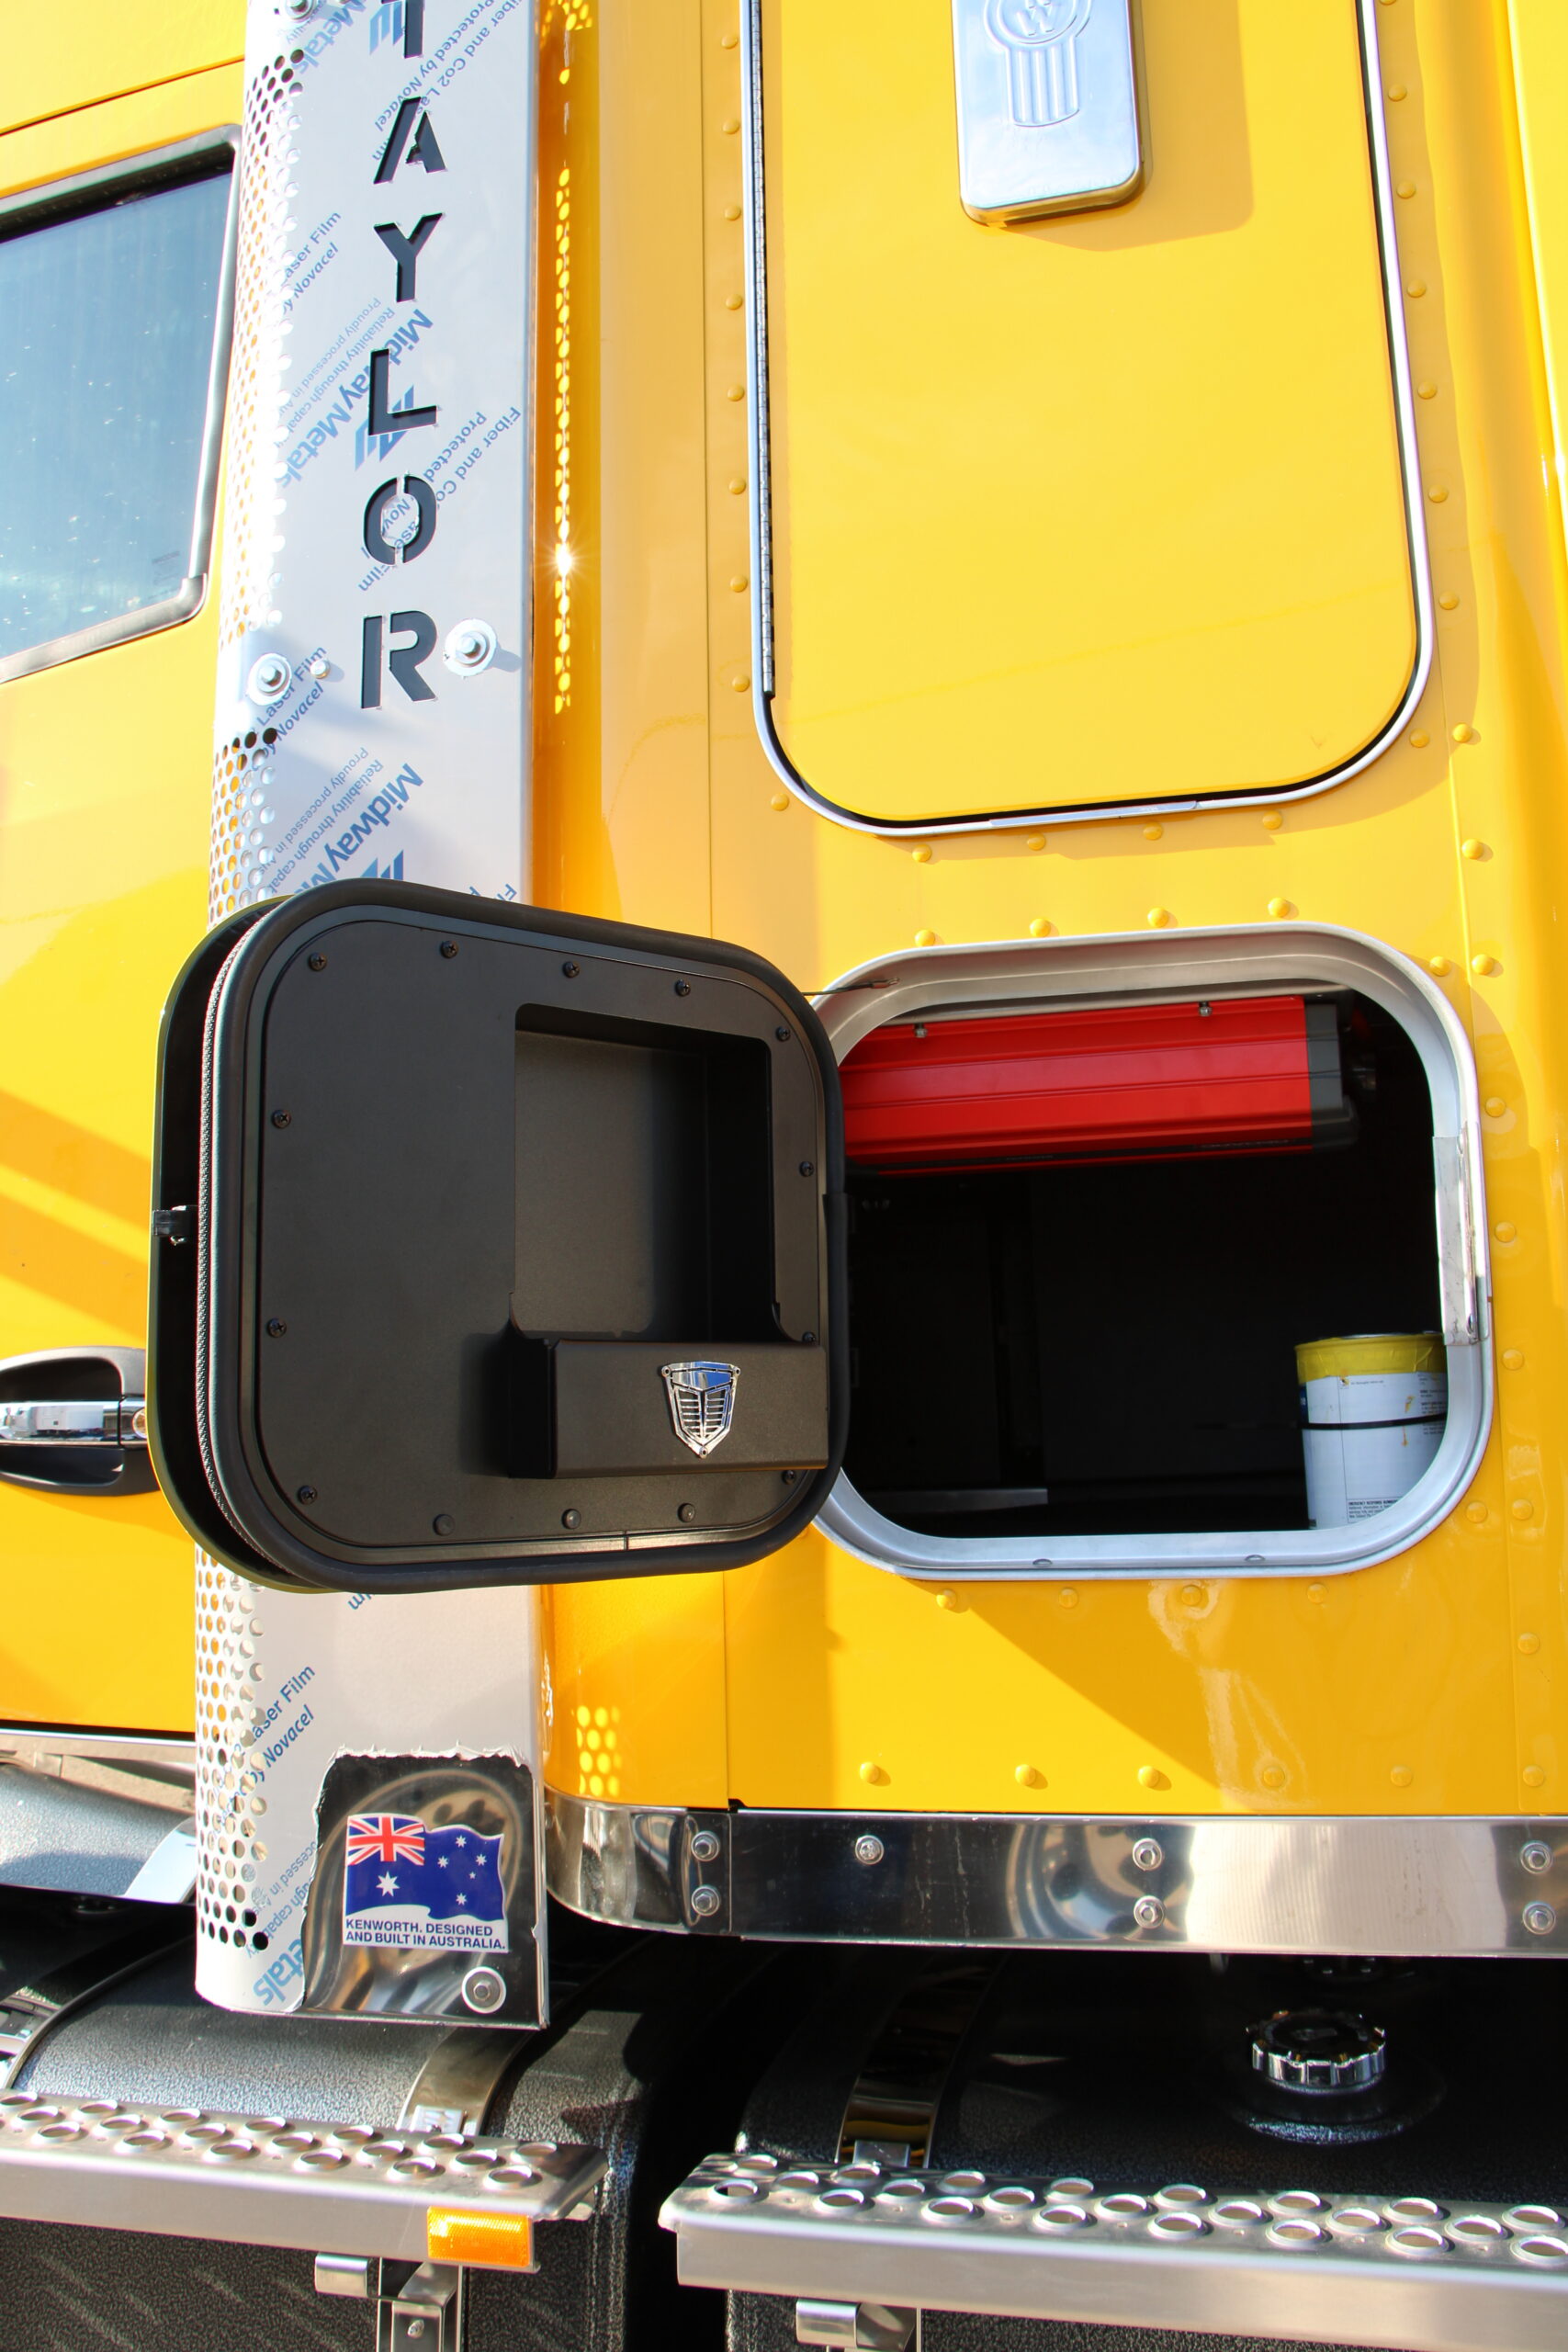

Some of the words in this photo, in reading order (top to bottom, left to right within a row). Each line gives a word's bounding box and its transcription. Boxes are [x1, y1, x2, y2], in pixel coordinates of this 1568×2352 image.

[491, 0, 521, 28] iber
[464, 26, 491, 58] and
[422, 59, 437, 77] by
[437, 56, 467, 87] Co2
[375, 76, 422, 131] Novacel
[419, 87, 440, 114] Las
[281, 243, 311, 286] aser
[310, 210, 341, 243] Film
[293, 241, 338, 298] Novacel
[345, 297, 381, 336] Proudly
[347, 307, 395, 361] Reliability
[301, 335, 346, 388] processed
[341, 308, 434, 409] Miday
[361, 0, 447, 709] TAYLOR
[310, 359, 349, 405] through
[423, 412, 486, 481] Protected
[472, 406, 522, 448] Fiber
[454, 447, 484, 480] and
[435, 479, 457, 510] Co
[362, 498, 410, 558] Novl
[393, 521, 418, 554] ase
[275, 681, 323, 740] Novacel
[331, 747, 368, 788] Proudly
[333, 759, 383, 815] Reliability
[284, 786, 332, 842] processed
[325, 763, 423, 868] Midway
[274, 841, 287, 854] in
[293, 815, 334, 862] through
[279, 1665, 315, 1702] Film
[262, 1703, 314, 1767] Novacel
[279, 1840, 317, 1884] ocessed
[269, 1883, 283, 1895] in
[345, 1918, 423, 1933] KENWORTH.
[425, 1923, 493, 1937] DESIGNED
[345, 1931, 372, 1942] AND
[375, 1932, 411, 1945] BUILT
[413, 1935, 426, 1946] IN
[429, 1936, 506, 1950] AUSTRALIA.
[250, 1939, 305, 2005] etals
